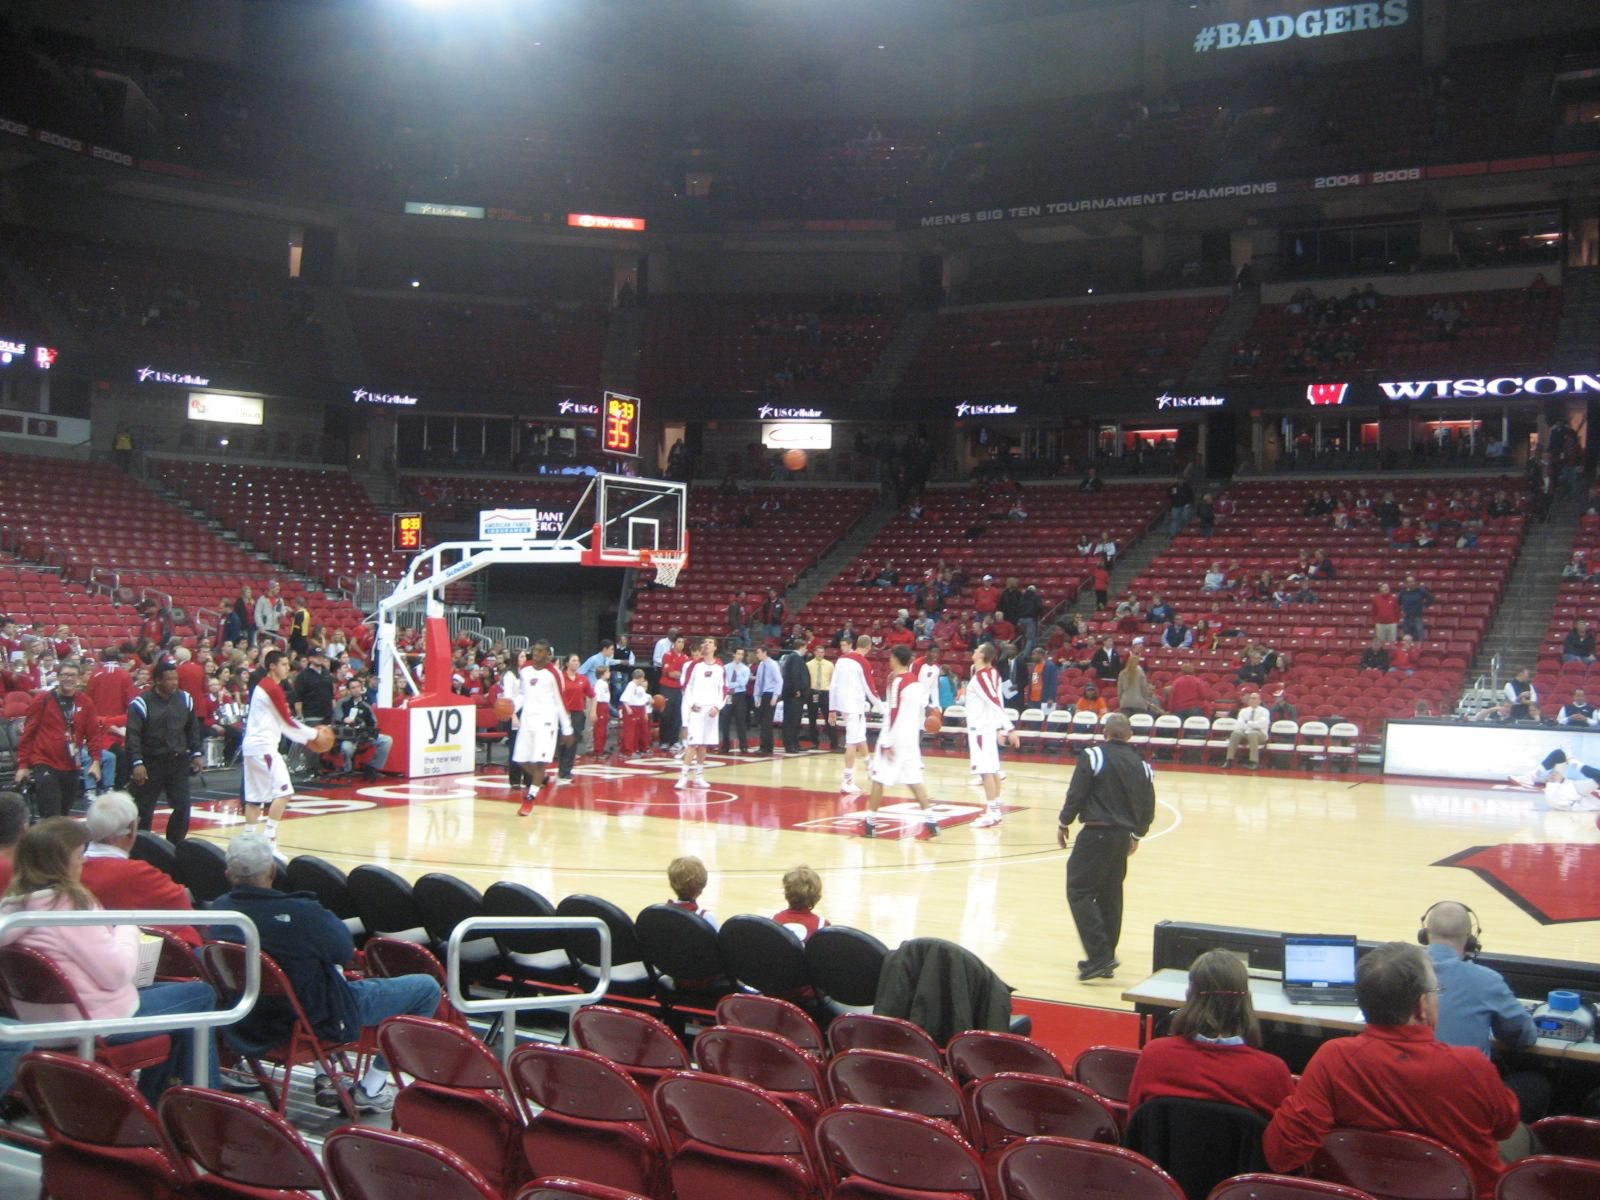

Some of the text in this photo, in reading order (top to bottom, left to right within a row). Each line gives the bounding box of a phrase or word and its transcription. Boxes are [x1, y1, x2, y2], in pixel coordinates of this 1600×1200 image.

[1193, 0, 1409, 53] #BADGERS
[921, 212, 971, 226] MEN'S
[976, 210, 1003, 221] BIG
[1009, 206, 1041, 218] TEN
[1046, 193, 1168, 214] TOURNAMENT
[1172, 182, 1277, 202] CHAMPIONS
[1314, 174, 1360, 189] 2004
[597, 218, 635, 229] TOYOTA
[172, 374, 210, 386] Cellular
[1378, 374, 1600, 400] WISCON
[382, 394, 418, 405] Cellular
[1188, 396, 1225, 406] Cellular
[788, 408, 822, 417] Cellular
[984, 404, 1018, 414] Cellular
[607, 417, 630, 449] 35
[401, 530, 417, 546] 35
[427, 708, 462, 744] yp
[424, 756, 435, 765] the
[450, 755, 462, 763] way
